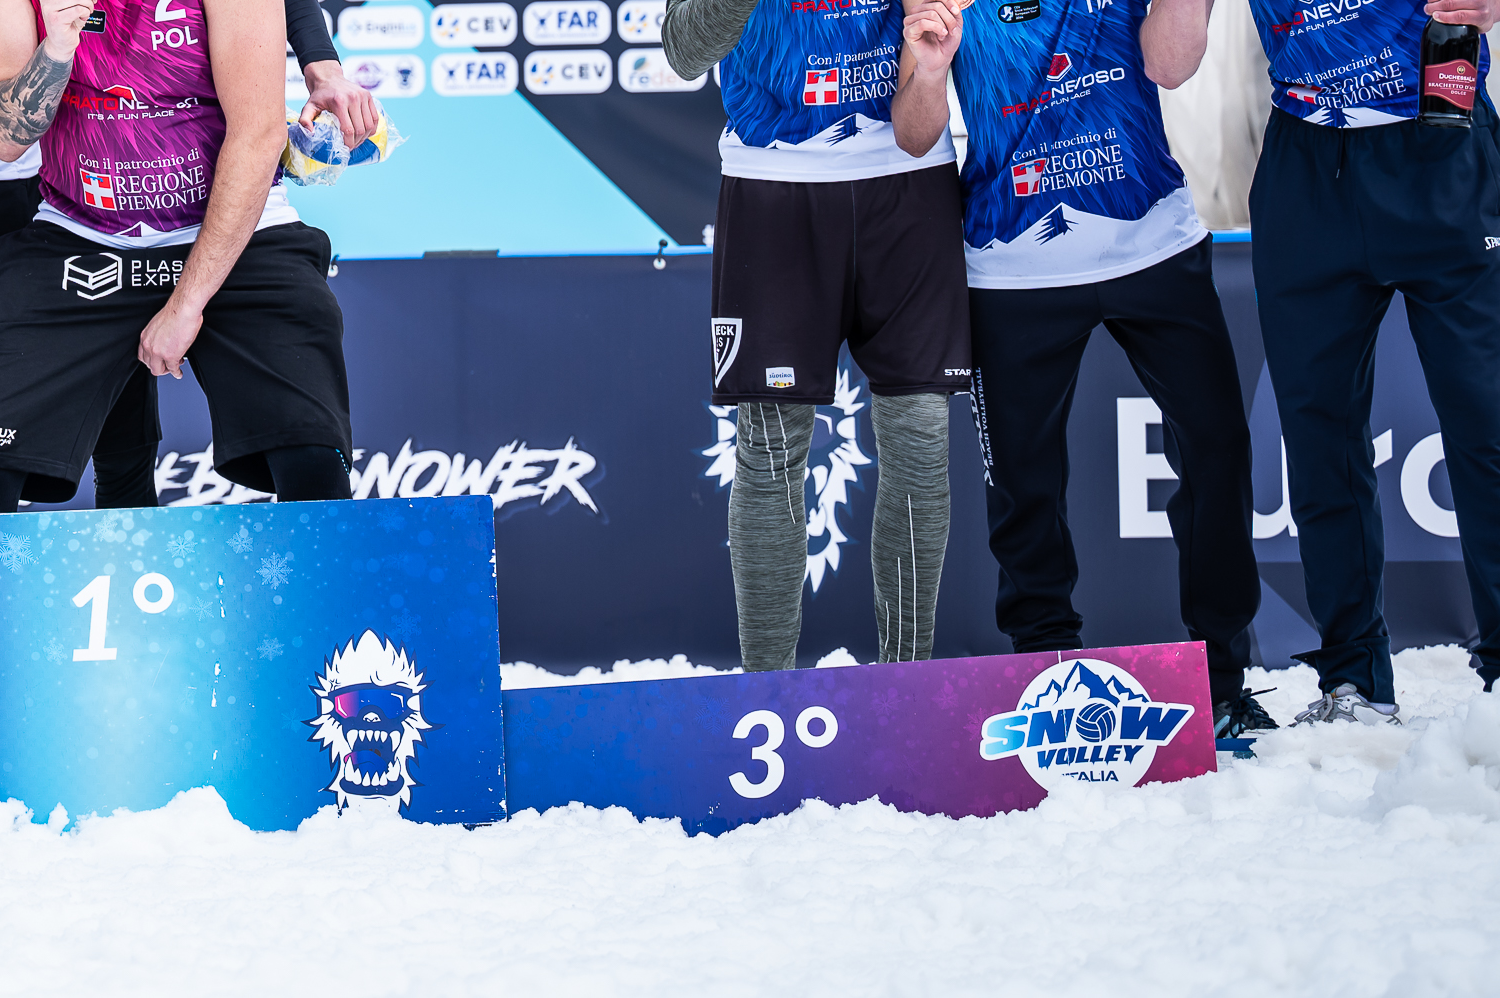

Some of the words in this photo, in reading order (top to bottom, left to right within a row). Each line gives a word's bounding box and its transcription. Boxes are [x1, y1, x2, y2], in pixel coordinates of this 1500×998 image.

[467, 17, 511, 33] CEV
[557, 10, 598, 29] FAR
[1306, 22, 1325, 32] FUN
[1327, 12, 1360, 26] PLACE
[151, 26, 199, 51] POL
[808, 54, 832, 66] Con
[834, 53, 841, 63] il
[844, 44, 895, 65] patrocinio
[1305, 72, 1314, 84] il
[1315, 54, 1377, 85] patrocinio
[1379, 46, 1393, 60] di
[466, 62, 507, 80] FAR
[561, 64, 607, 79] CEV
[841, 59, 900, 86] REGION
[841, 79, 897, 103] PIEMON
[1318, 78, 1407, 109] PIEMONTE
[142, 110, 175, 119] PLACE
[1012, 148, 1036, 161] Con
[1040, 142, 1048, 153] il
[1104, 128, 1117, 139] di
[79, 153, 100, 169] Con
[102, 158, 111, 170] il
[115, 154, 184, 173] patrocinio
[187, 148, 200, 161] di
[1043, 144, 1123, 174] REGIONE
[114, 165, 205, 194] REGIONE
[1041, 163, 1126, 192] PIEMONTE
[117, 184, 207, 211] PIEMONTE
[131, 260, 184, 273] PLAS
[975, 366, 988, 430] VOLLEYBALL
[1037, 745, 1144, 770] VOLLEY
